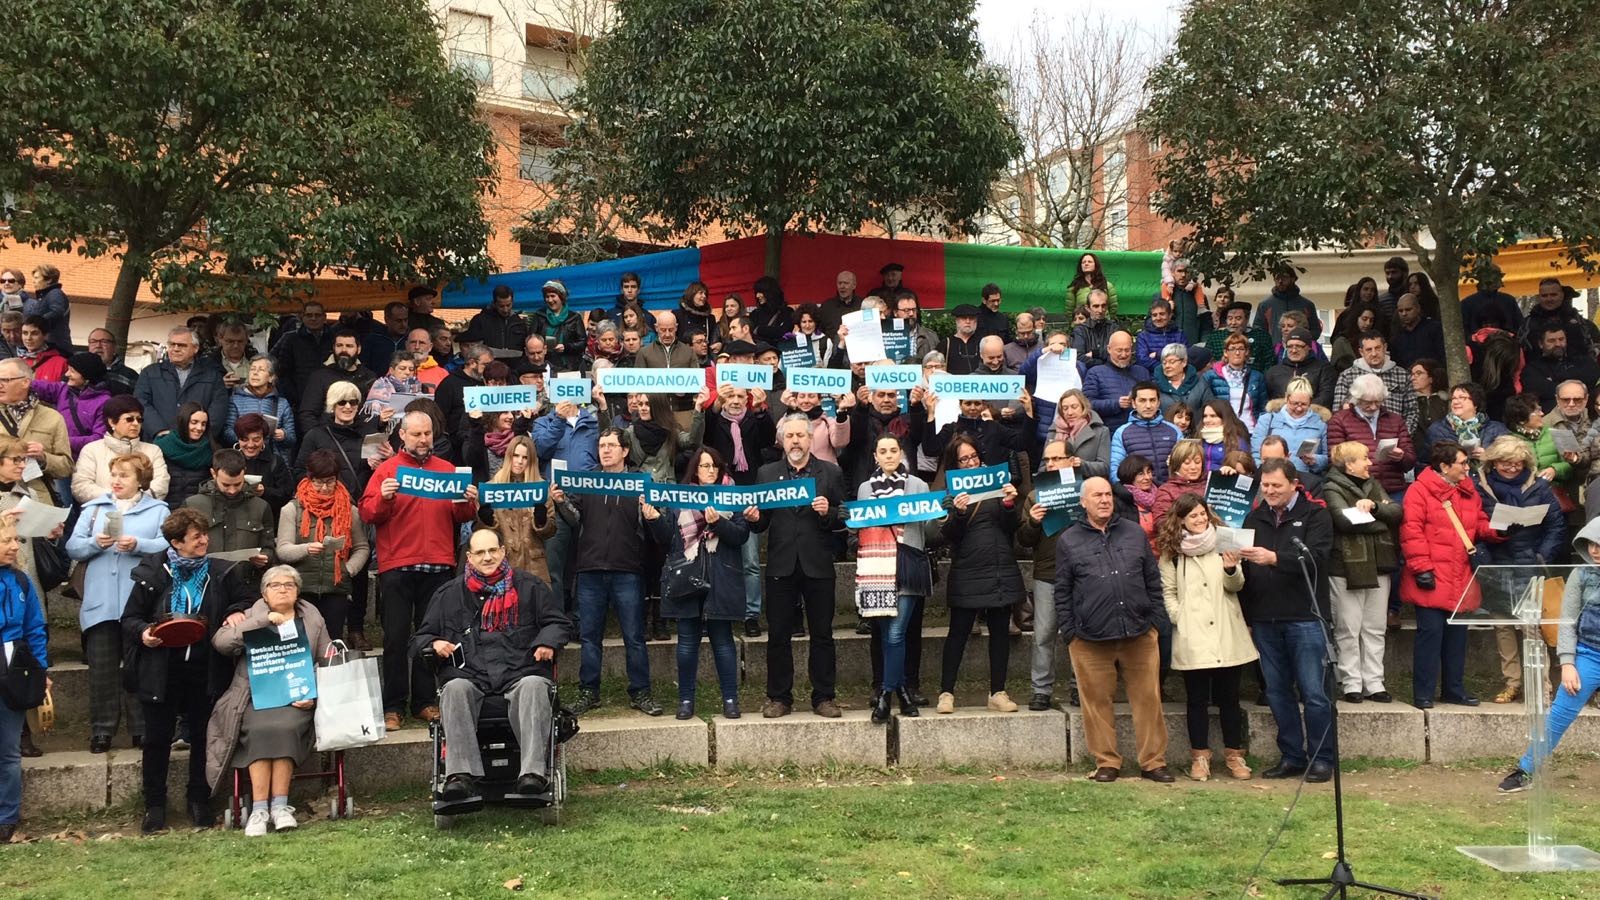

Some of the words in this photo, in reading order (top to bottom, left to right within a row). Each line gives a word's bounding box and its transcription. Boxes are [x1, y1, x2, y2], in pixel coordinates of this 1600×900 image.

[602, 374, 700, 387] CIUDADANO/A
[721, 370, 738, 382] DE
[747, 371, 767, 383] UN
[792, 374, 846, 388] ESTADO
[871, 371, 917, 383] VASCO
[556, 385, 585, 397] SER
[934, 381, 1008, 394] SOBERANO
[1012, 381, 1021, 393] ?
[480, 391, 531, 406] QUIERE
[401, 474, 465, 494] EUSKAL
[561, 475, 645, 492] BURUJABE
[951, 475, 994, 491] DOZU
[998, 470, 1006, 484] ?
[484, 488, 543, 503] ESTATU
[650, 489, 709, 505] BATEKO
[713, 485, 809, 506] HERRITARRA
[850, 505, 887, 521] IZAN
[898, 497, 944, 517] GURA
[361, 724, 370, 735] k
